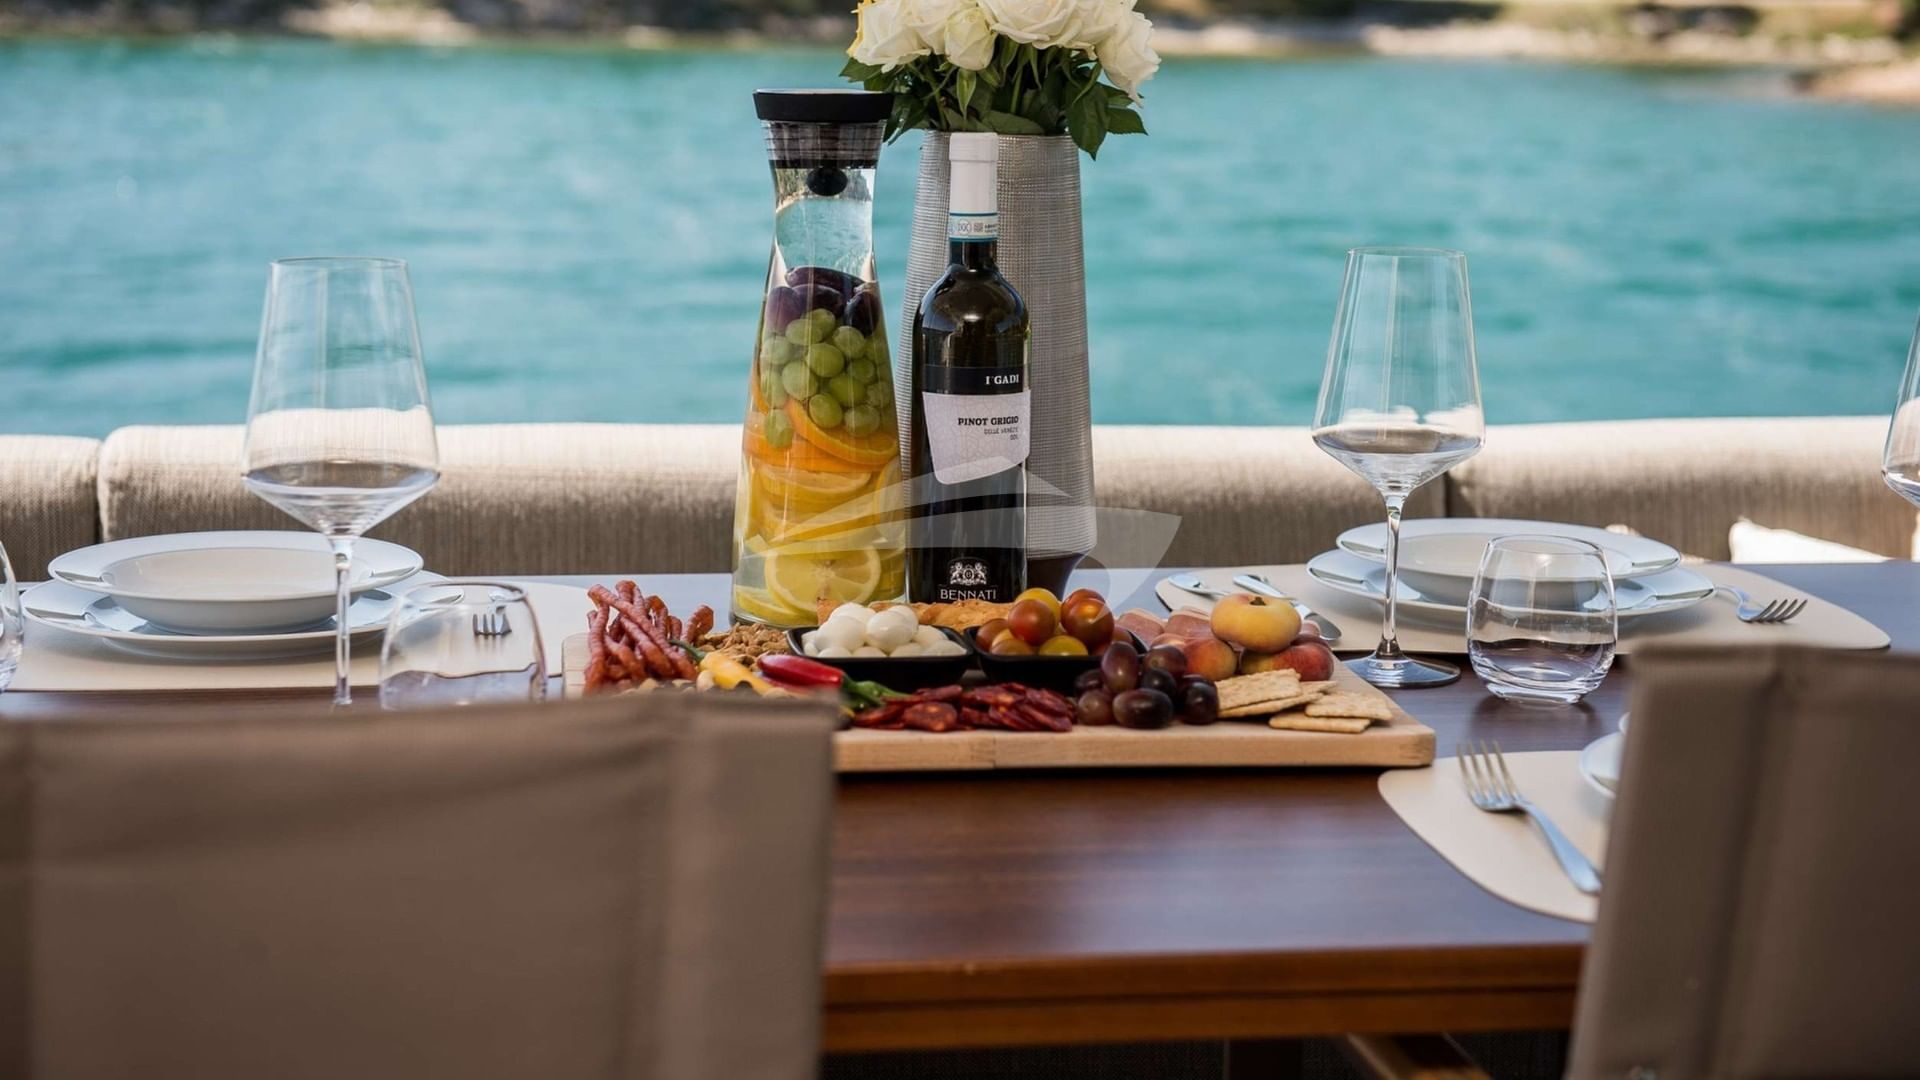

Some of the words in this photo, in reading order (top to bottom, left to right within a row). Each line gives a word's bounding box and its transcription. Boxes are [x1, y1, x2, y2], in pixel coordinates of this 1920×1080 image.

[957, 417, 988, 426] PINOT
[990, 415, 1019, 426] GRIGIO
[940, 588, 997, 601] BENNATI
